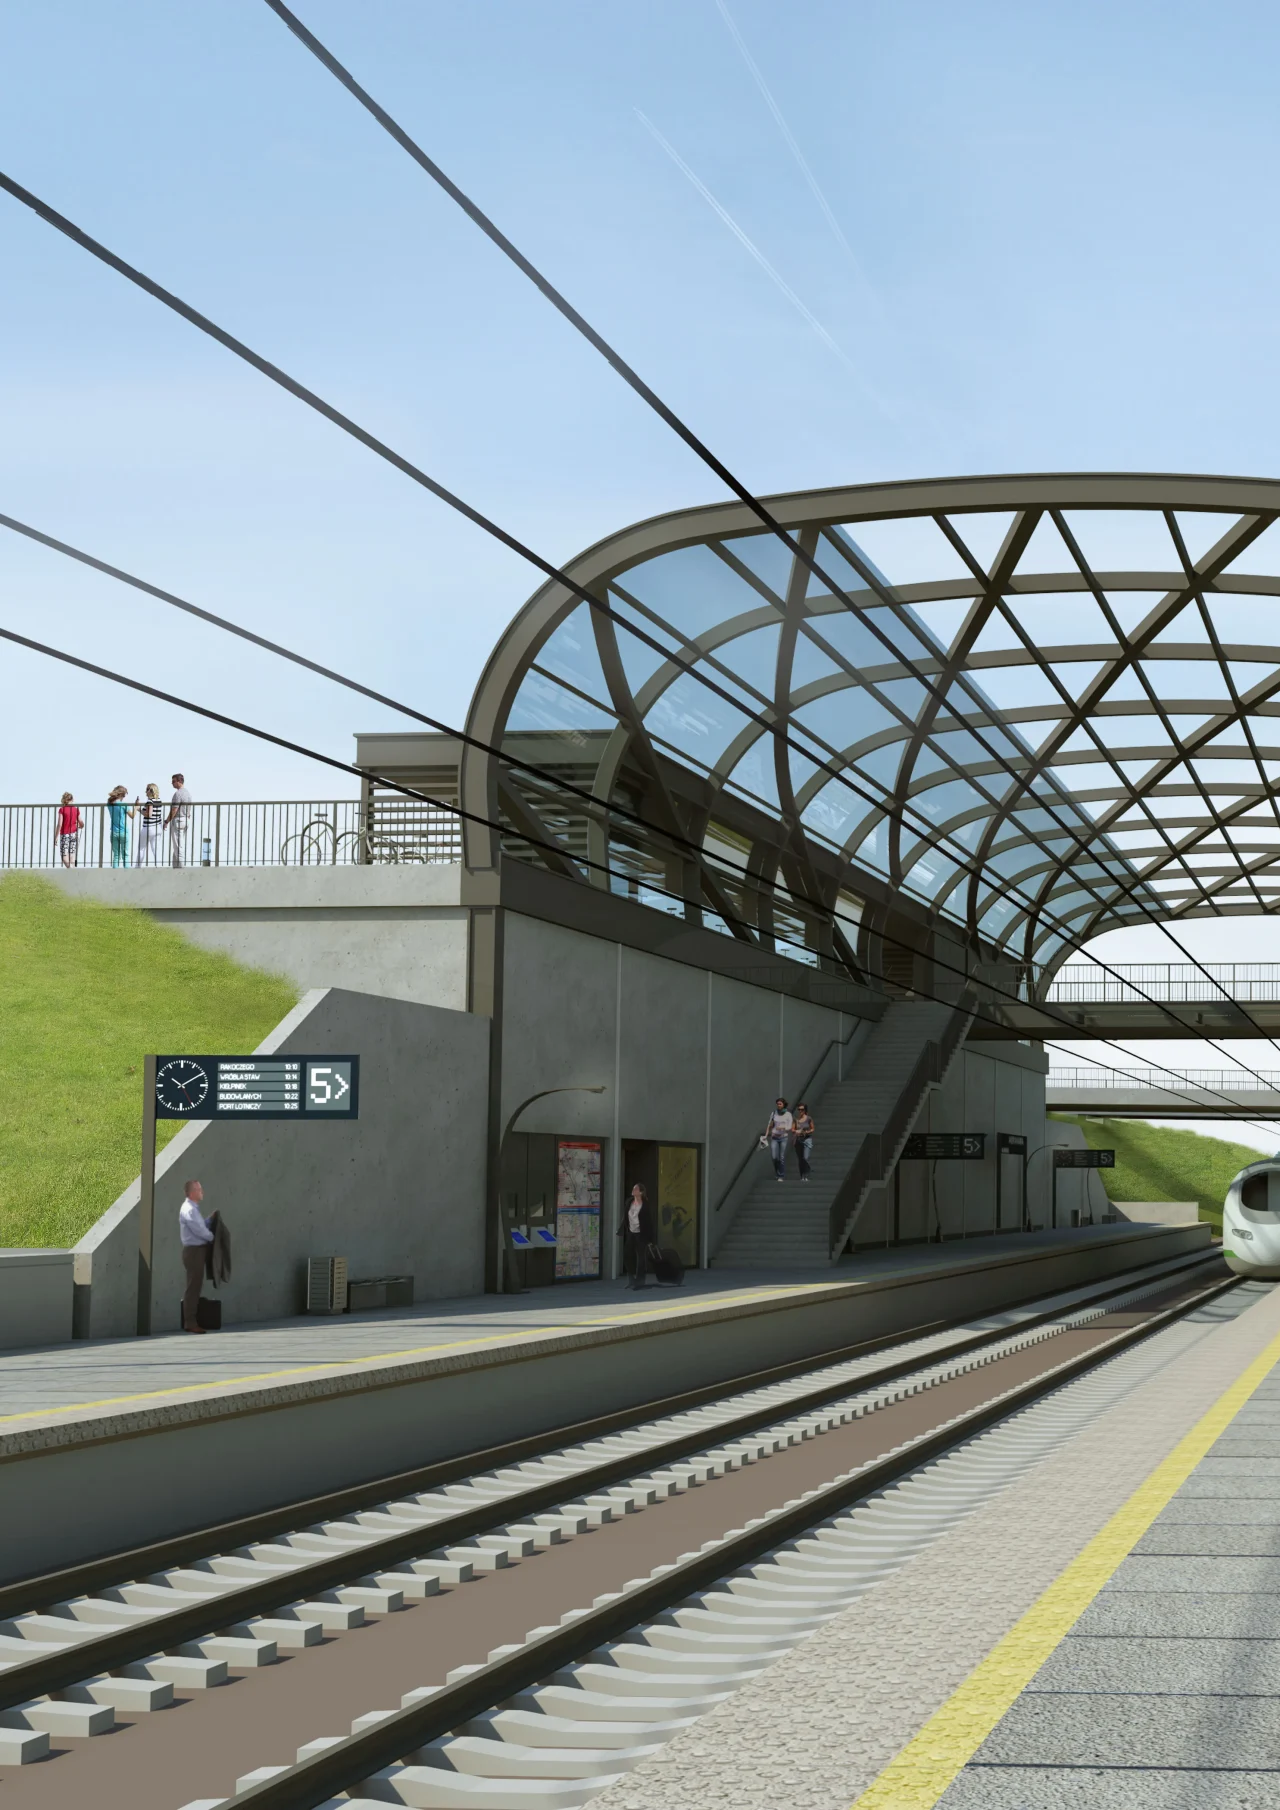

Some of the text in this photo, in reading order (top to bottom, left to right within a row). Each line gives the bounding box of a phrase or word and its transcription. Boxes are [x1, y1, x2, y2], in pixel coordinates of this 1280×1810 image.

[311, 1068, 331, 1103] 5
[964, 1138, 973, 1153] 5
[1100, 1153, 1108, 1164] 5
